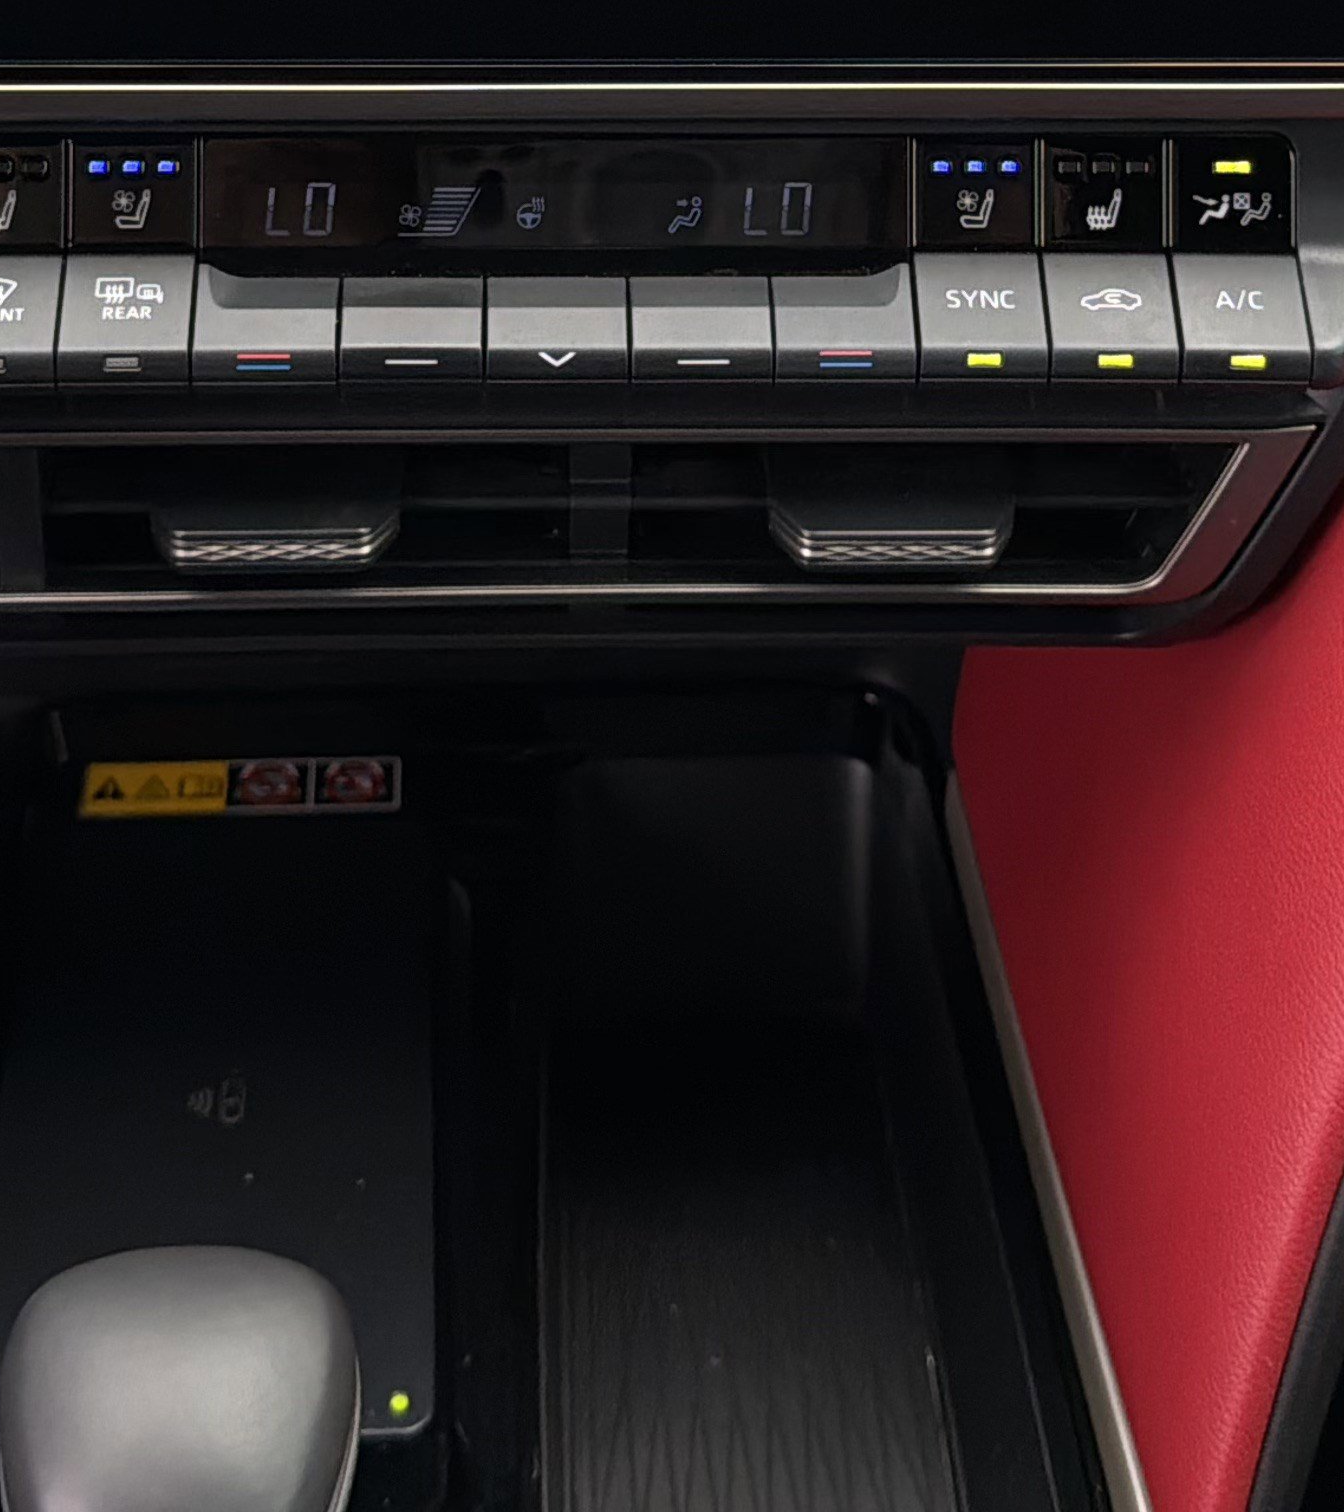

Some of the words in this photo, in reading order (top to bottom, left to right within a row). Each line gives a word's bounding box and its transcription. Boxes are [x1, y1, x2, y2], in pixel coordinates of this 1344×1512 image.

[945, 289, 1016, 310] SYNC
[1215, 289, 1265, 311] A/C
[101, 305, 152, 320] REAR
